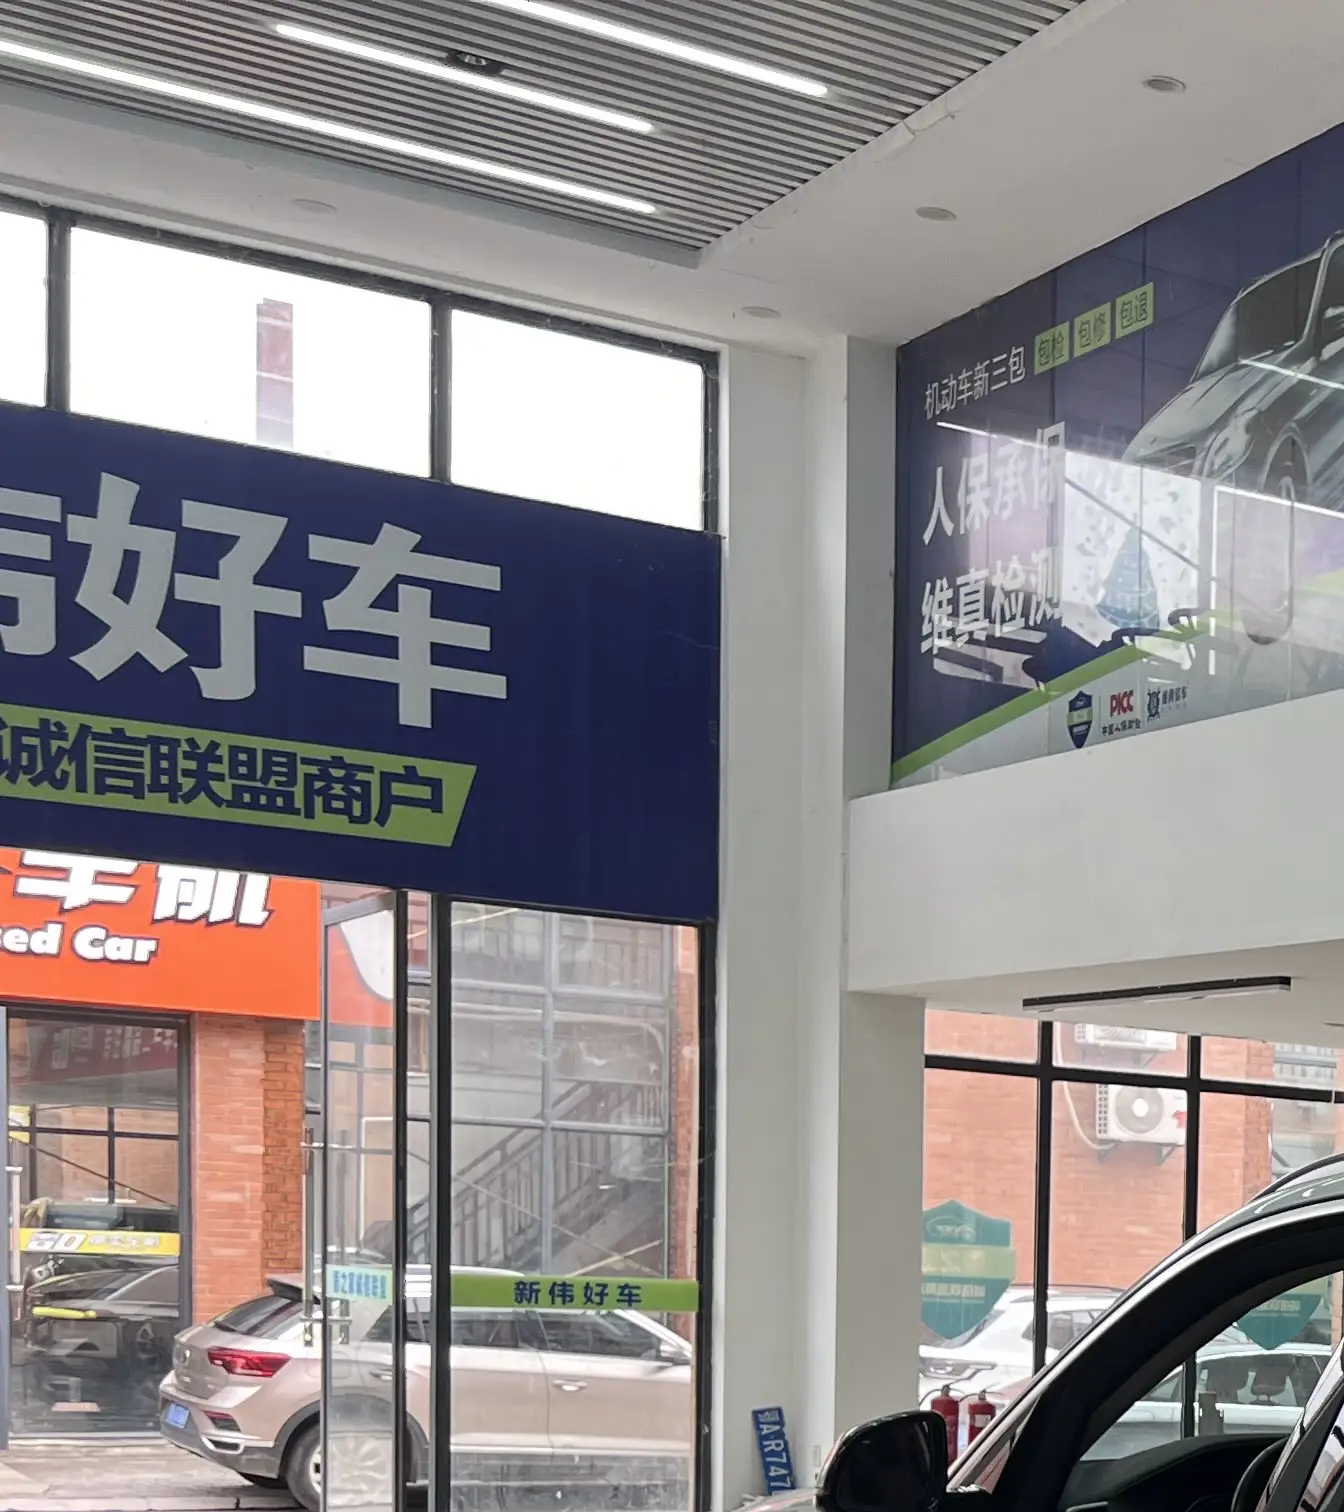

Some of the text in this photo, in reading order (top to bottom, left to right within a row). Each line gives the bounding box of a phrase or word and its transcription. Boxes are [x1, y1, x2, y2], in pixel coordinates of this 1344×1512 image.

[925, 291, 1149, 420] 机动车新三包 包检 包修 包退
[0, 472, 509, 730] 好车
[920, 546, 1064, 656] 维真检测
[1109, 689, 1134, 718] PICC
[0, 717, 444, 828] 诚信联盟商户
[0, 920, 160, 965] ed Car
[514, 1280, 643, 1307] 新伟好车
